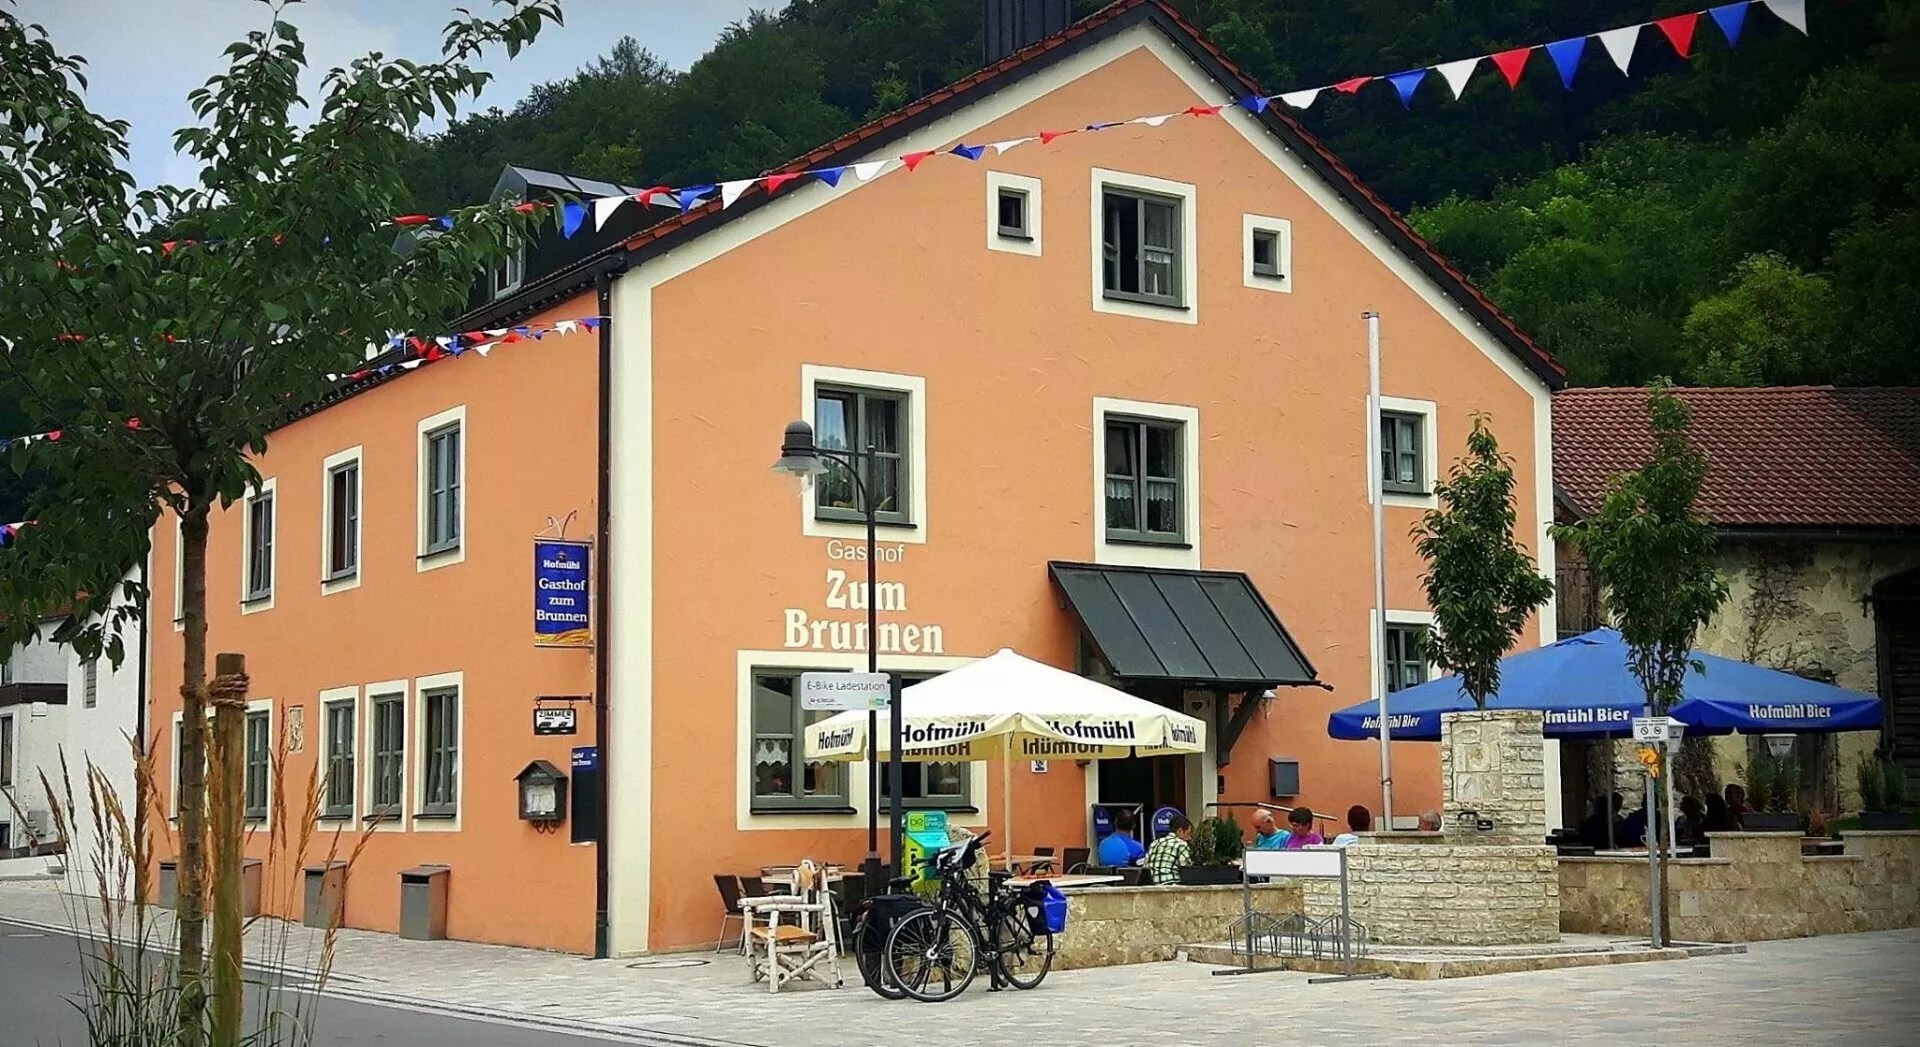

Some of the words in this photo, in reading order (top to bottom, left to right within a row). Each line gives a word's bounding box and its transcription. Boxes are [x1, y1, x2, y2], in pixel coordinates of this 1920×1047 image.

[543, 560, 580, 569] Hofmühl
[539, 578, 586, 590] Gasthof
[549, 597, 575, 606] zum
[536, 609, 587, 622] Brunnen
[807, 681, 834, 691] E-Bike
[836, 681, 886, 691] Ladestation
[1544, 708, 1593, 724] fmühl
[1597, 708, 1629, 722] Bier
[1749, 704, 1805, 718] Hofmühl
[1807, 704, 1831, 718] Bier
[1402, 714, 1420, 728] Bier
